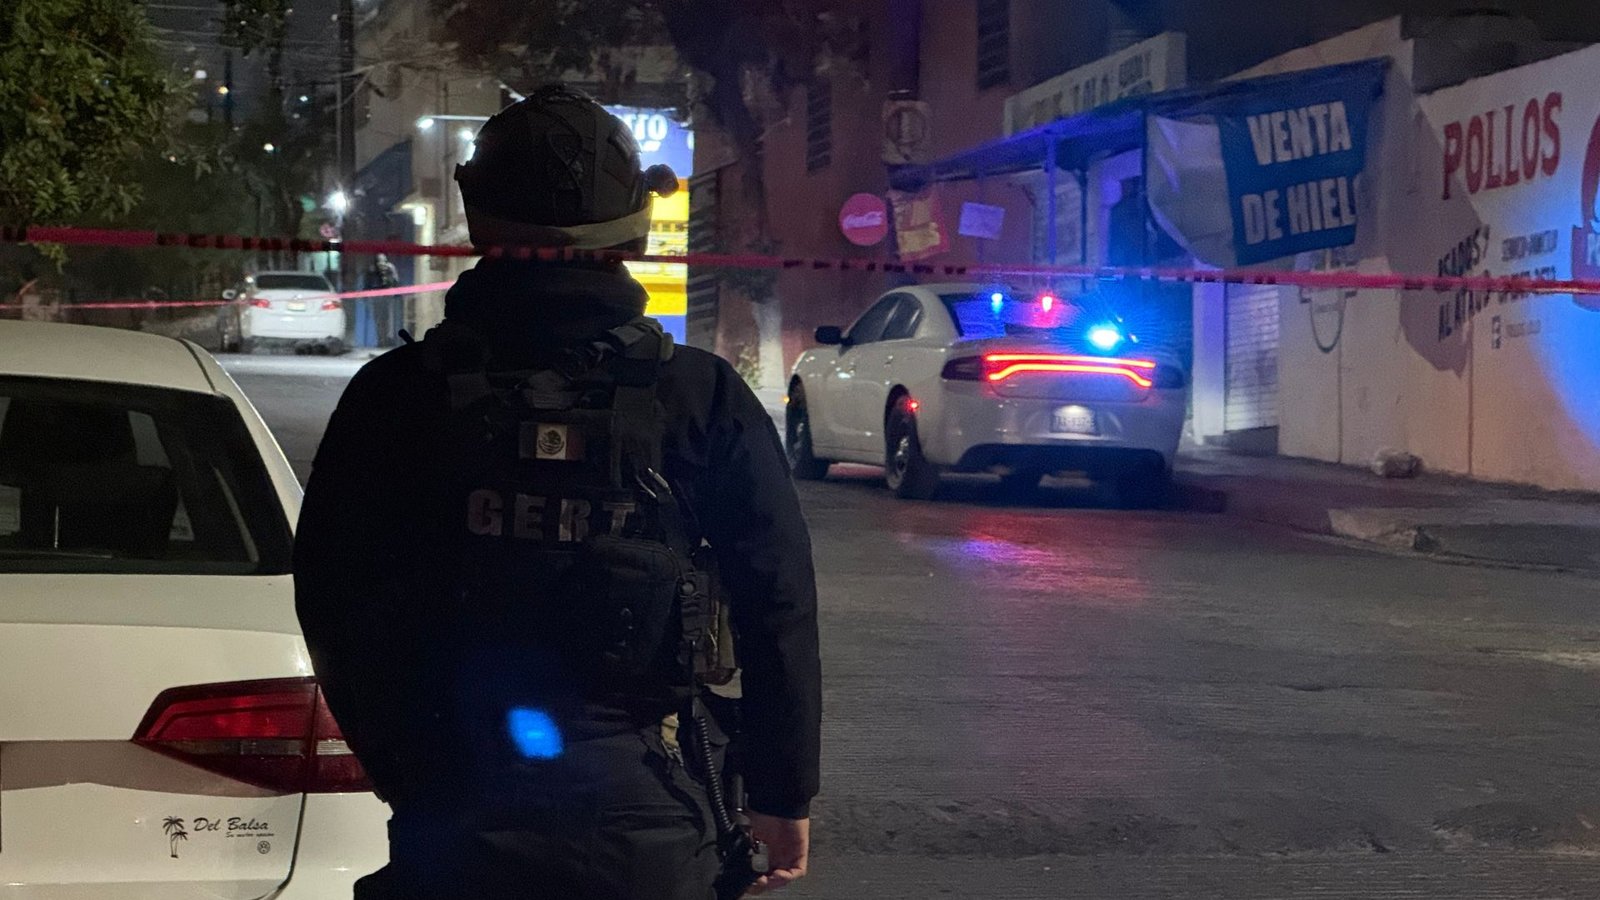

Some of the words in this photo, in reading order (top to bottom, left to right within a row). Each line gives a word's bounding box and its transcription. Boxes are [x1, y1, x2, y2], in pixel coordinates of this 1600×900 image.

[1246, 100, 1352, 166] VENTA
[1443, 91, 1562, 200] POLLOS
[1241, 188, 1284, 245] DE
[467, 488, 636, 542] GERT
[193, 817, 221, 832] Del
[227, 816, 268, 831] Balsa
